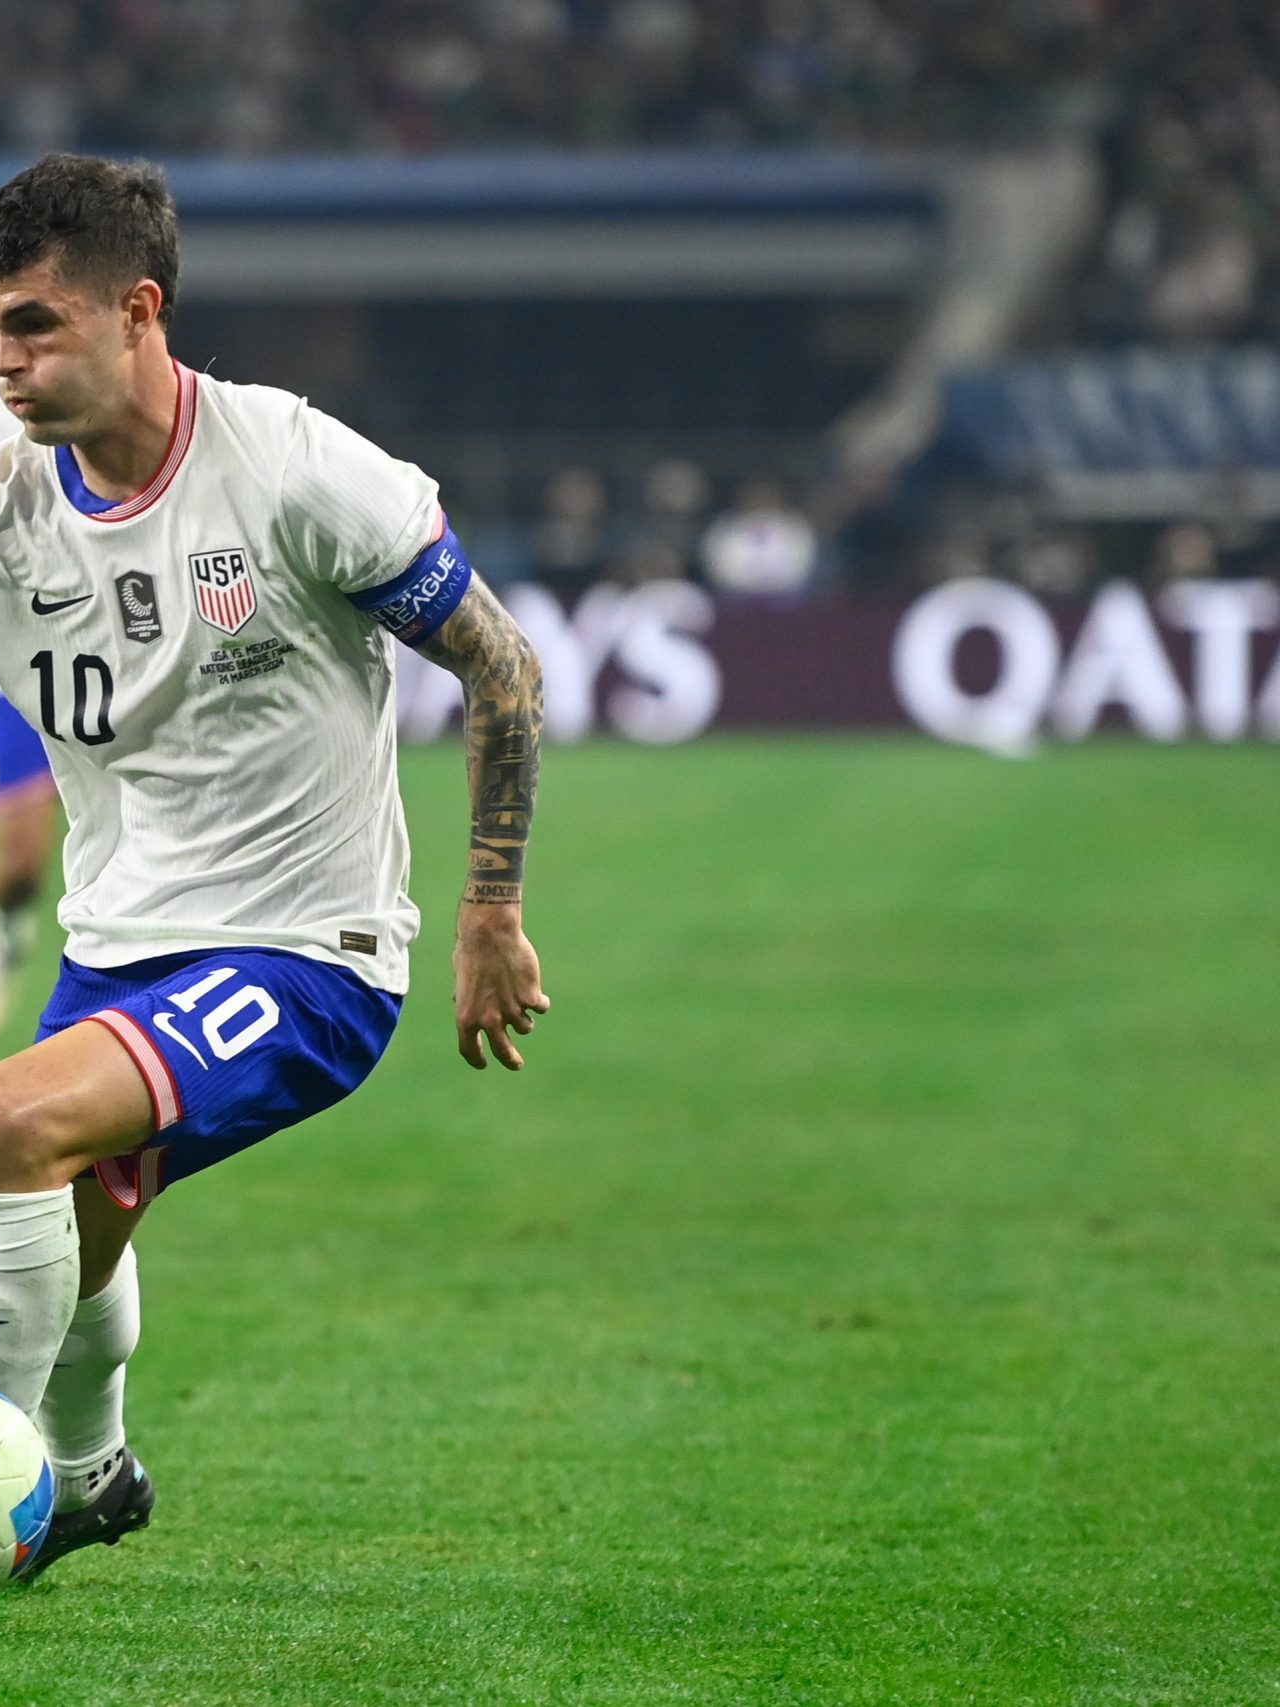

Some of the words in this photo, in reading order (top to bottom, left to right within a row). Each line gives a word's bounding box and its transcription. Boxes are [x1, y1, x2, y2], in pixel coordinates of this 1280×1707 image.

[195, 554, 245, 587] USA
[386, 548, 456, 631] LEAGUE
[425, 562, 466, 620] FINALS
[199, 661, 235, 675] NATIONS
[236, 652, 271, 670] LEAGUE
[271, 643, 299, 659] FINAL
[210, 650, 229, 662] USA
[245, 637, 279, 655] MEXICO
[218, 674, 229, 685] 24
[230, 667, 262, 683] MARCH
[262, 658, 285, 673] 2024
[30, 651, 117, 746] 10
[167, 967, 280, 1061] 10
